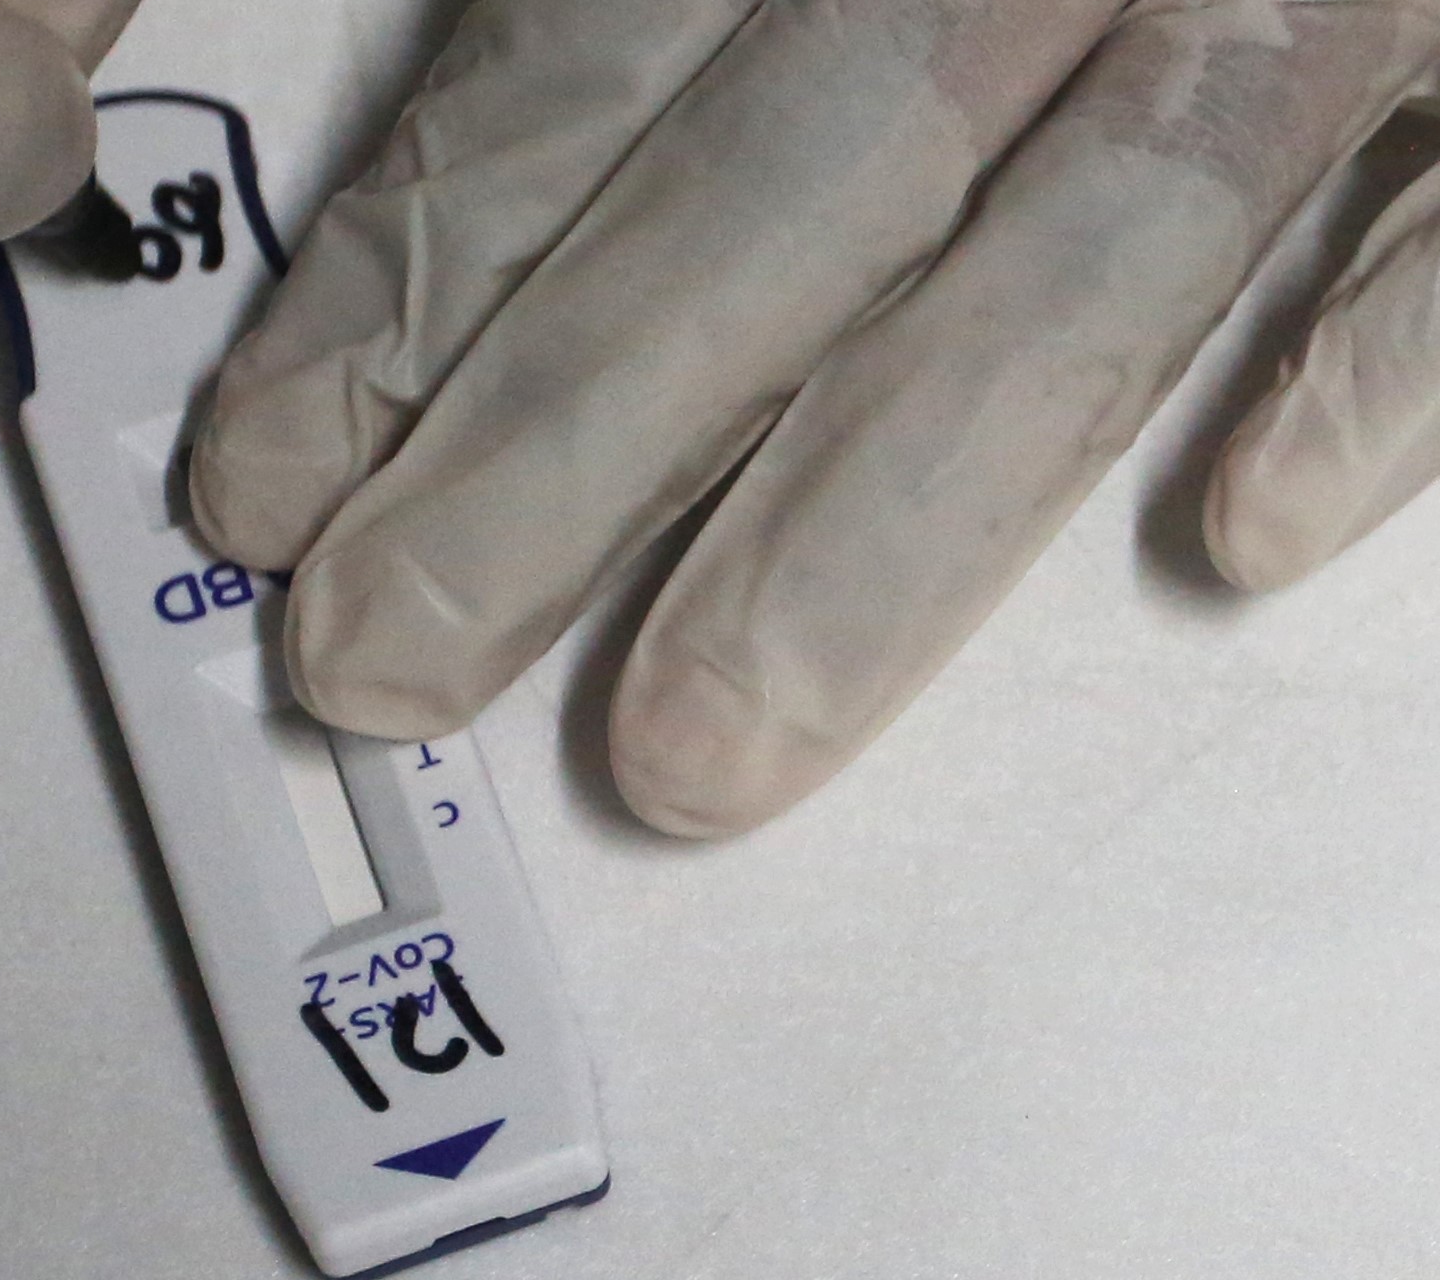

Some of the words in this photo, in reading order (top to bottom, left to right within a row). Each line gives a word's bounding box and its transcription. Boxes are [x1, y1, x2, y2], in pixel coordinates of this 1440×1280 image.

[153, 560, 255, 626] BD
[418, 744, 441, 769] T
[433, 799, 461, 828] C
